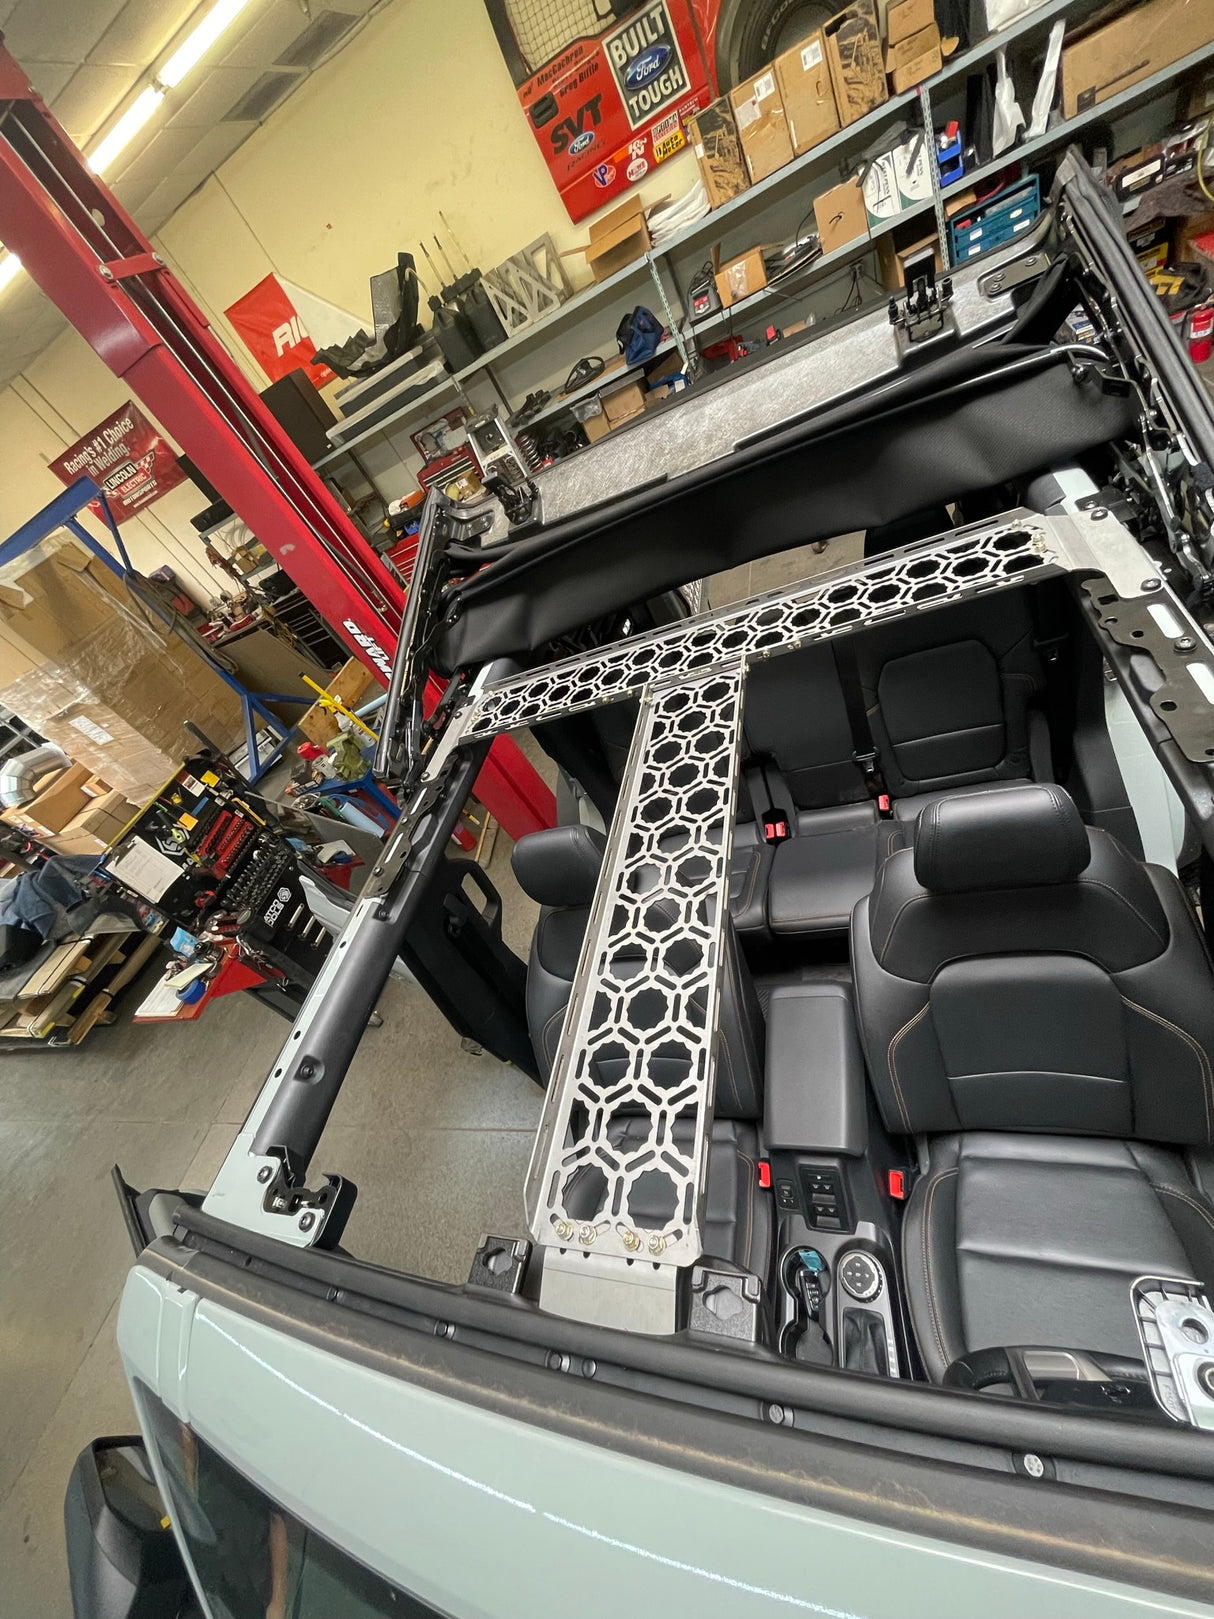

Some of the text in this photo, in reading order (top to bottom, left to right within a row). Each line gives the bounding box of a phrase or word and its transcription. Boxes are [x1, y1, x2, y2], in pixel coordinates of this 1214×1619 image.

[610, 4, 665, 69] BUILT
[636, 55, 660, 81] Ford
[629, 65, 683, 117] TOUGH
[550, 92, 602, 155] SVT
[662, 134, 679, 148] Auto
[662, 138, 683, 158] Meter
[593, 164, 608, 187] VP
[63, 417, 134, 475] Racing's #1 Choice
[86, 464, 99, 477] in
[105, 464, 137, 489] LINCOLN
[120, 472, 147, 494] ELECTRIC
[263, 899, 280, 921] ATCO
